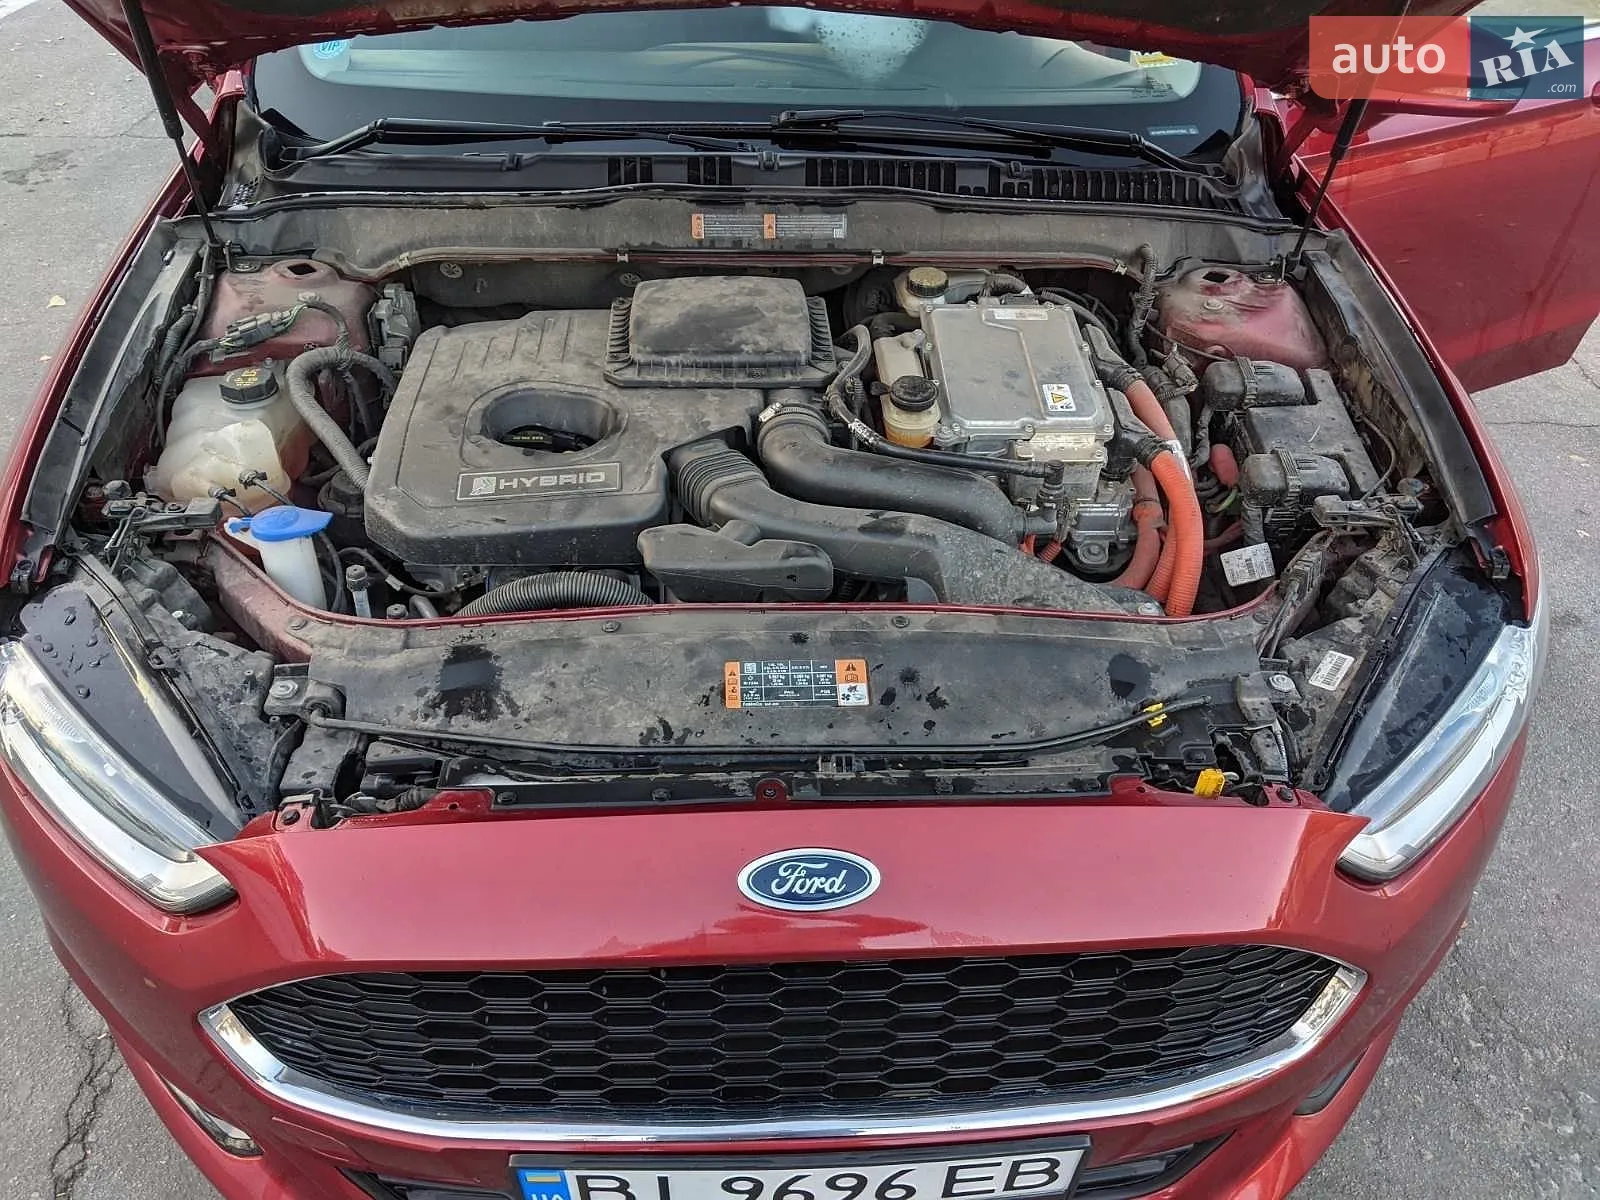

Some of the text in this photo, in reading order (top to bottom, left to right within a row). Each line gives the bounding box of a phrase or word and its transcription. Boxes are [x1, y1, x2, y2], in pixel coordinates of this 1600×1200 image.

[499, 471, 606, 490] HYBRID
[771, 861, 848, 895] Ford
[720, 1168, 917, 1200] 9696
[941, 1157, 1061, 1198] EB
